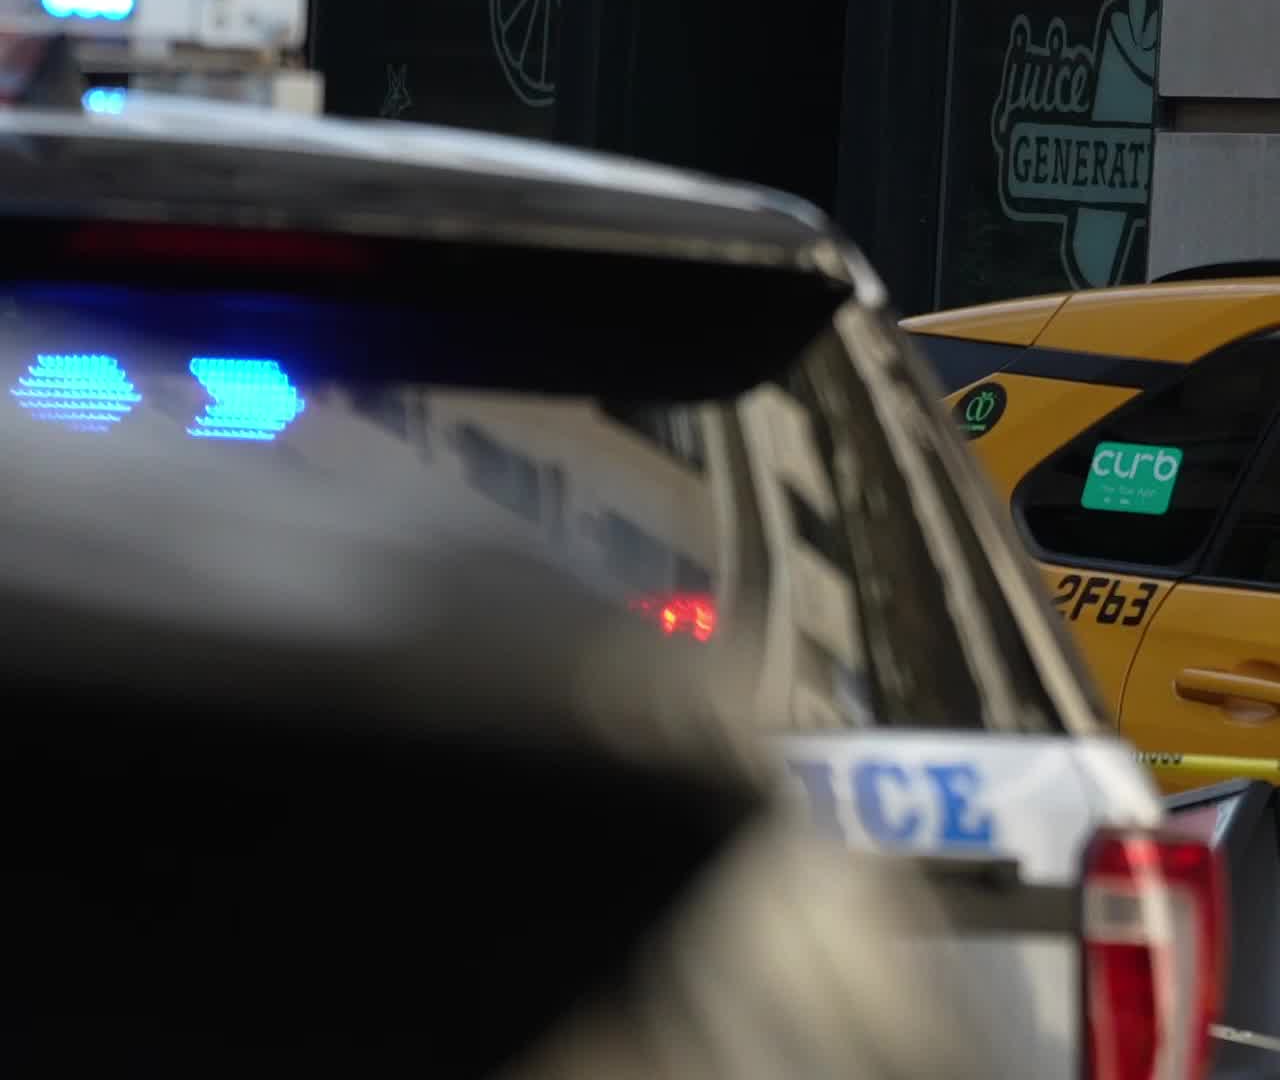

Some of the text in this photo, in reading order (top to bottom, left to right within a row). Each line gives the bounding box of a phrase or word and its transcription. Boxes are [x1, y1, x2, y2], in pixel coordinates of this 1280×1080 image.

[1000, 32, 1090, 134] juice
[1013, 135, 1153, 189] GENERAT
[1091, 449, 1180, 482] curb
